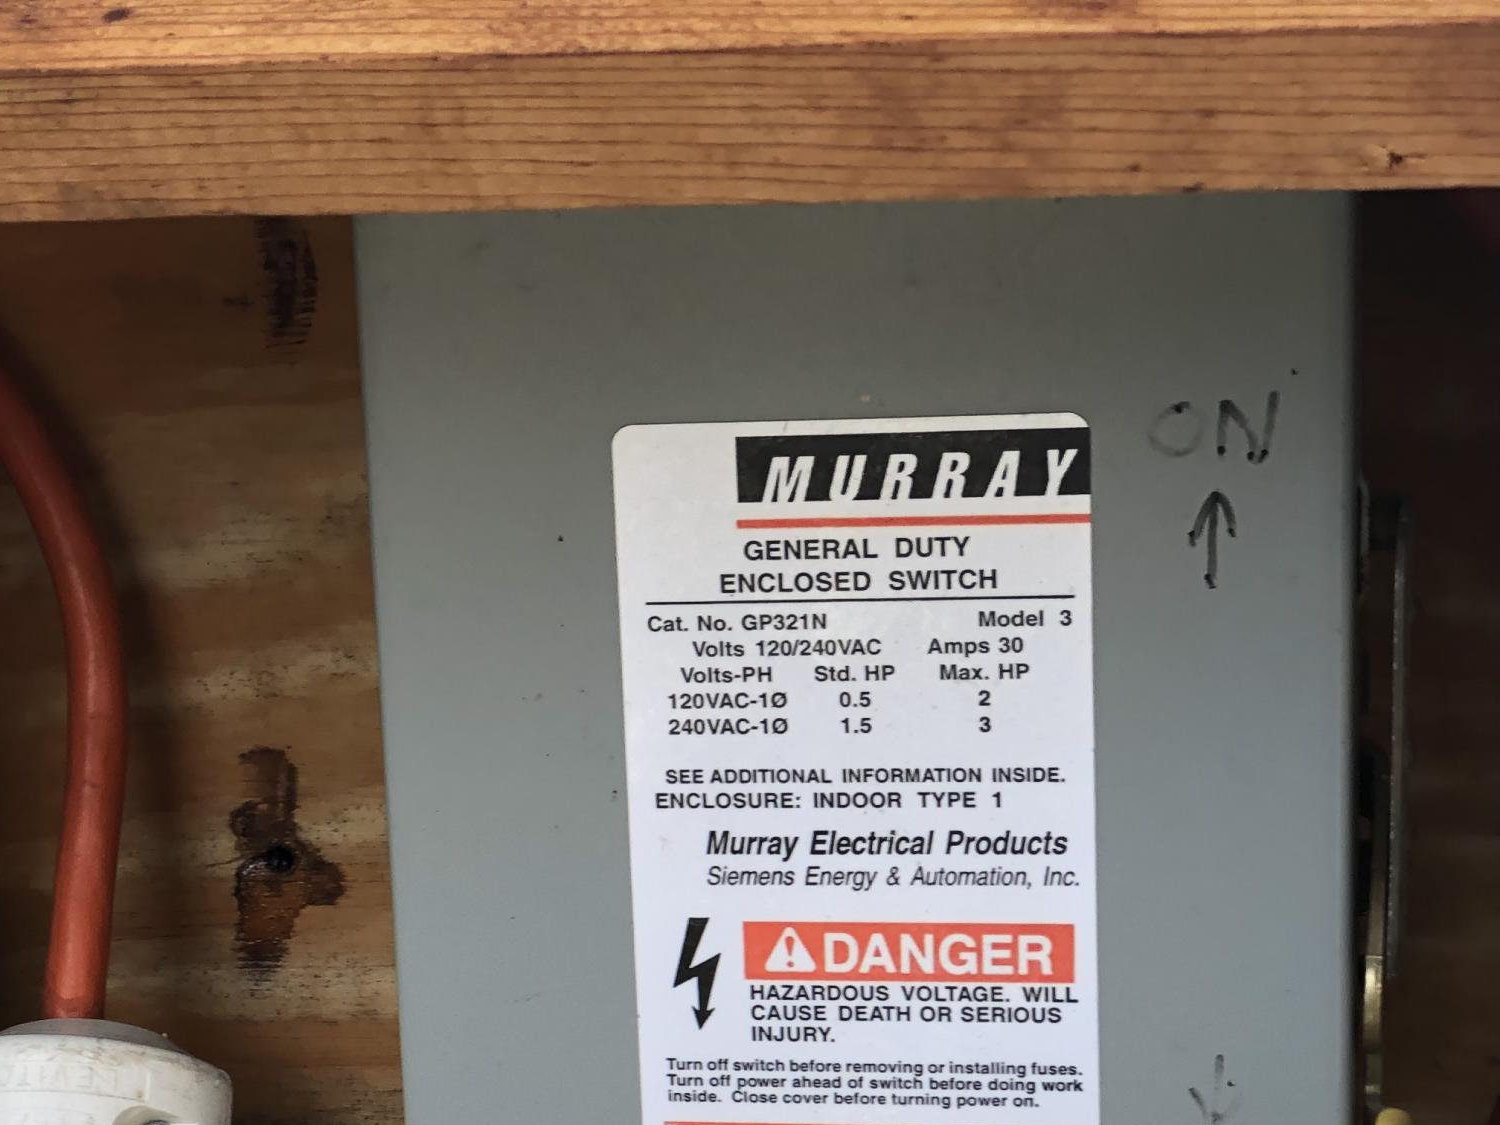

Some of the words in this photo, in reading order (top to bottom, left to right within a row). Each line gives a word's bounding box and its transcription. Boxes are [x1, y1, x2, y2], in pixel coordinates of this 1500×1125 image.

[1149, 391, 1279, 463] ON
[762, 448, 1078, 502] MURRAY
[744, 538, 878, 560] GENERAL
[895, 536, 968, 557] DUTY
[720, 571, 870, 593] ENCLOSED
[889, 569, 996, 590] SWITCH
[647, 615, 687, 632] Cat.
[697, 615, 731, 631] No.
[741, 613, 826, 631] GP321N
[978, 610, 1043, 627] Model
[1060, 609, 1071, 626] 3
[692, 641, 744, 657] Volts
[756, 638, 881, 656] 120/240VAC
[927, 638, 989, 657] Amps
[999, 637, 1023, 653] 30
[680, 666, 771, 683] Volts-PH
[814, 665, 855, 682] Std.
[865, 665, 894, 681] HP
[940, 664, 988, 680] Max.
[998, 663, 1029, 679] HP
[839, 691, 870, 707] 0.5
[978, 690, 990, 706] 2
[841, 718, 872, 733] 1.5
[979, 716, 991, 732] 3
[666, 769, 703, 784] SEE
[710, 768, 832, 783] ADDITIONAL
[842, 767, 981, 783] INFORMATION
[992, 767, 1065, 782] INSIDE.
[655, 792, 800, 808] ENCLOSURE:
[813, 792, 901, 808] INDOOR
[917, 791, 976, 808] TYPE
[992, 792, 1000, 807] 1
[706, 830, 799, 860] Murray
[810, 830, 933, 855] Electrical
[945, 830, 1067, 855] Products
[707, 865, 794, 886] Siemens
[805, 866, 877, 890] Energy
[886, 866, 899, 885] &
[910, 866, 1031, 889] Automation,
[1044, 866, 1079, 886] Inc.
[823, 932, 1054, 976] DANGER
[750, 984, 888, 1001] HAZARDOUS
[901, 985, 1009, 1002] VOLTAGE.
[1022, 986, 1078, 1003] WILL
[751, 1004, 826, 1021] CAUSE
[838, 1005, 910, 1021] DEATH
[920, 1006, 951, 1022] OR
[961, 1006, 1061, 1023] SERIOUS
[752, 1026, 834, 1042] INJURY.
[666, 1057, 702, 1070] Turn
[707, 1058, 728, 1070] off
[733, 1059, 784, 1071] switch
[789, 1059, 841, 1072] before
[846, 1060, 923, 1076] removing
[927, 1064, 944, 1073] or
[949, 1061, 1026, 1078] installing
[1031, 1062, 1082, 1075] fuses.
[666, 1073, 703, 1086] Turn
[709, 1074, 730, 1086] off
[737, 1077, 786, 1090] power
[792, 1076, 841, 1088] ahead
[847, 1076, 863, 1088] of
[869, 1077, 922, 1089] switch
[929, 1077, 981, 1090] before
[987, 1078, 1035, 1093] doing
[1041, 1079, 1082, 1091] work
[668, 1089, 721, 1102] inside.
[731, 1090, 777, 1103] Close
[782, 1094, 828, 1104] cover
[834, 1092, 886, 1104] before
[891, 1093, 950, 1109] turning
[956, 1096, 1007, 1108] power
[1012, 1097, 1038, 1107] on.
